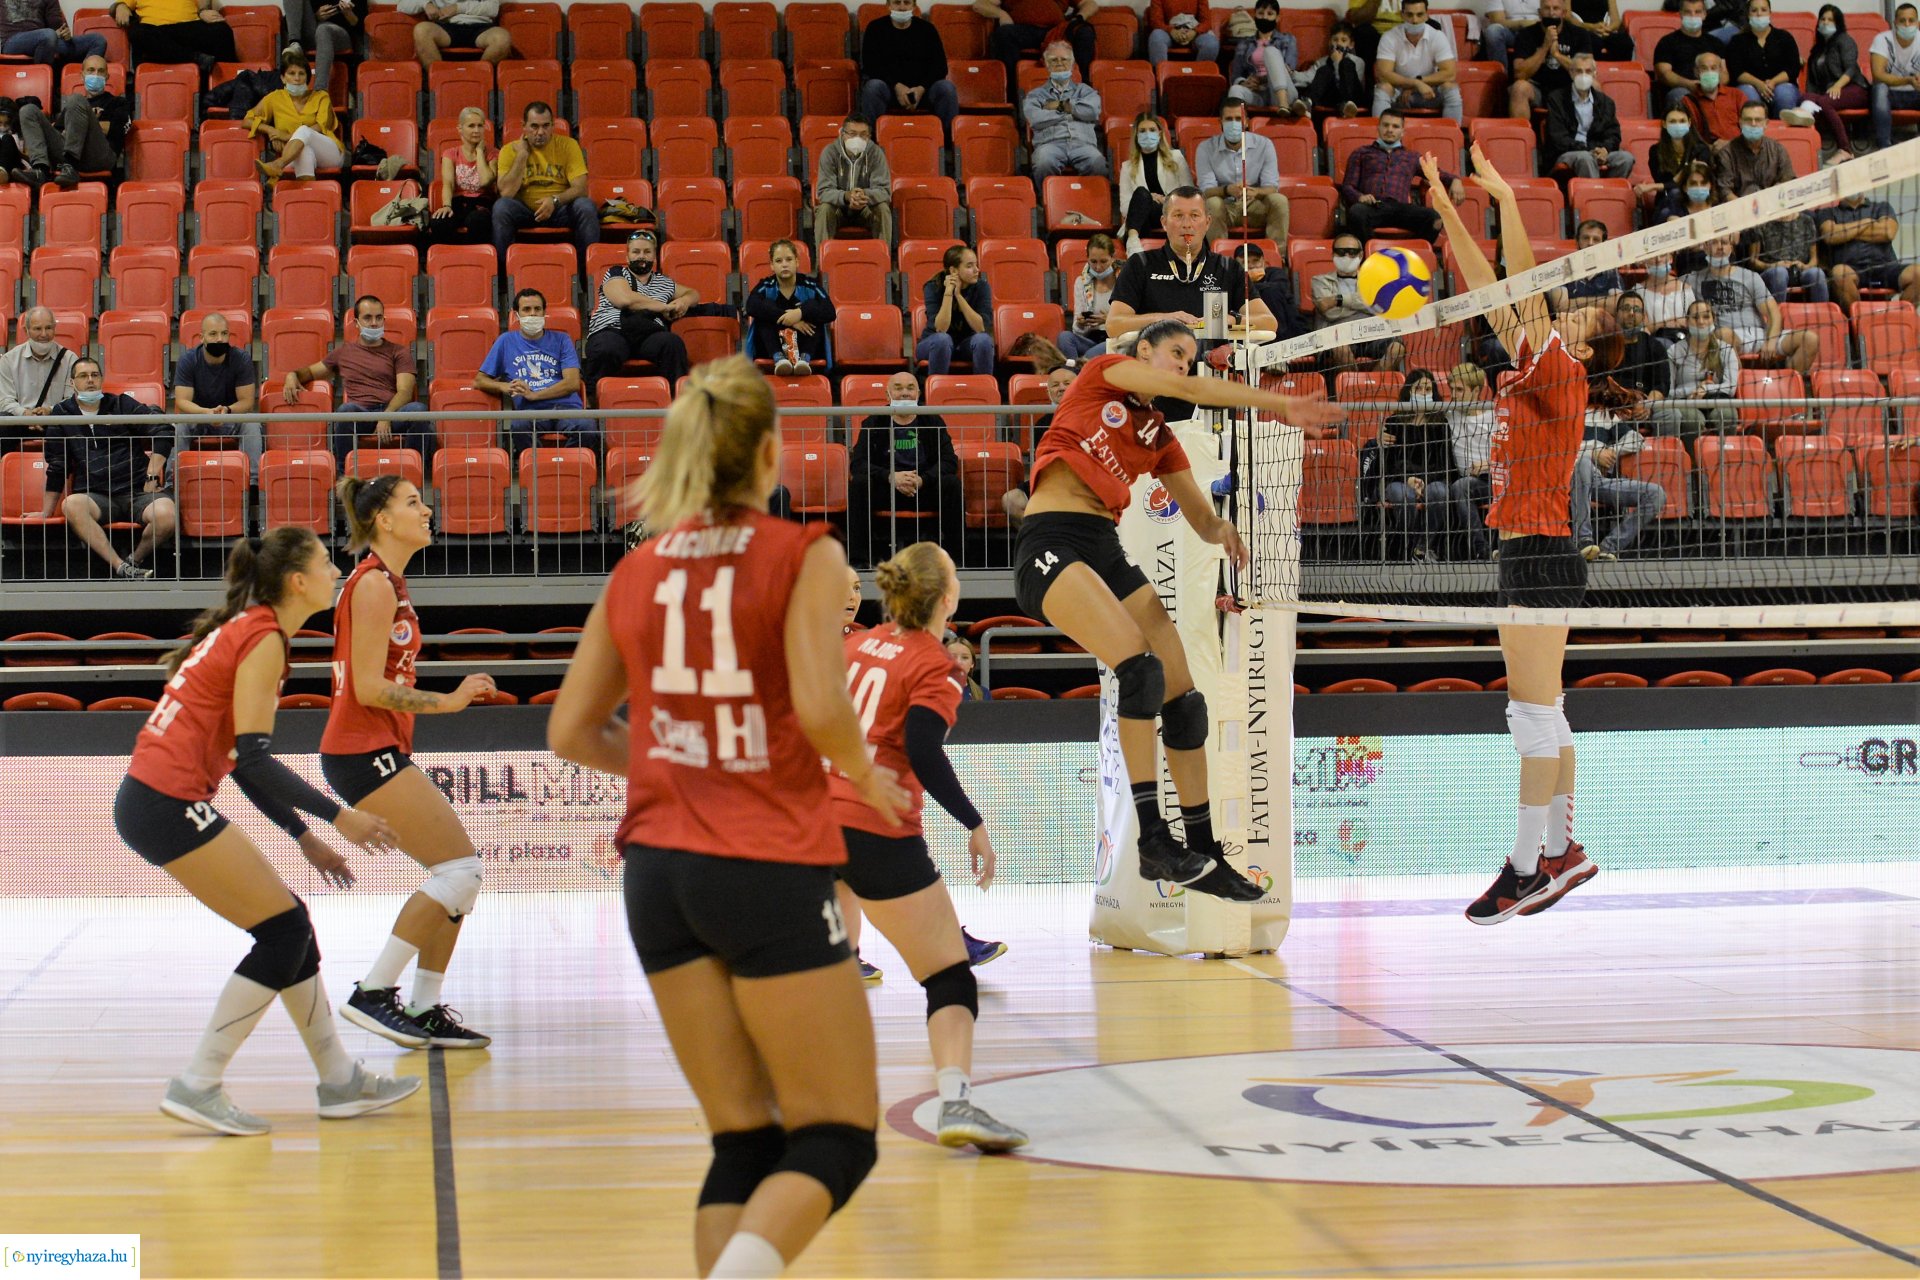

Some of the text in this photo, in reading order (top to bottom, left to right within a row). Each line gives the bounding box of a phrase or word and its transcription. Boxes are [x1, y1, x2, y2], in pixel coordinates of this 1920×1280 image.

[526, 164, 567, 178] ELAX
[527, 354, 557, 366] STRAUSS
[1137, 418, 1160, 446] 14
[1034, 550, 1060, 576] 14
[1153, 538, 1177, 616] HÁZA
[651, 564, 755, 698] 11
[714, 703, 768, 761] H
[373, 752, 397, 777] 17
[425, 763, 528, 805] RILL
[185, 801, 218, 832] 12
